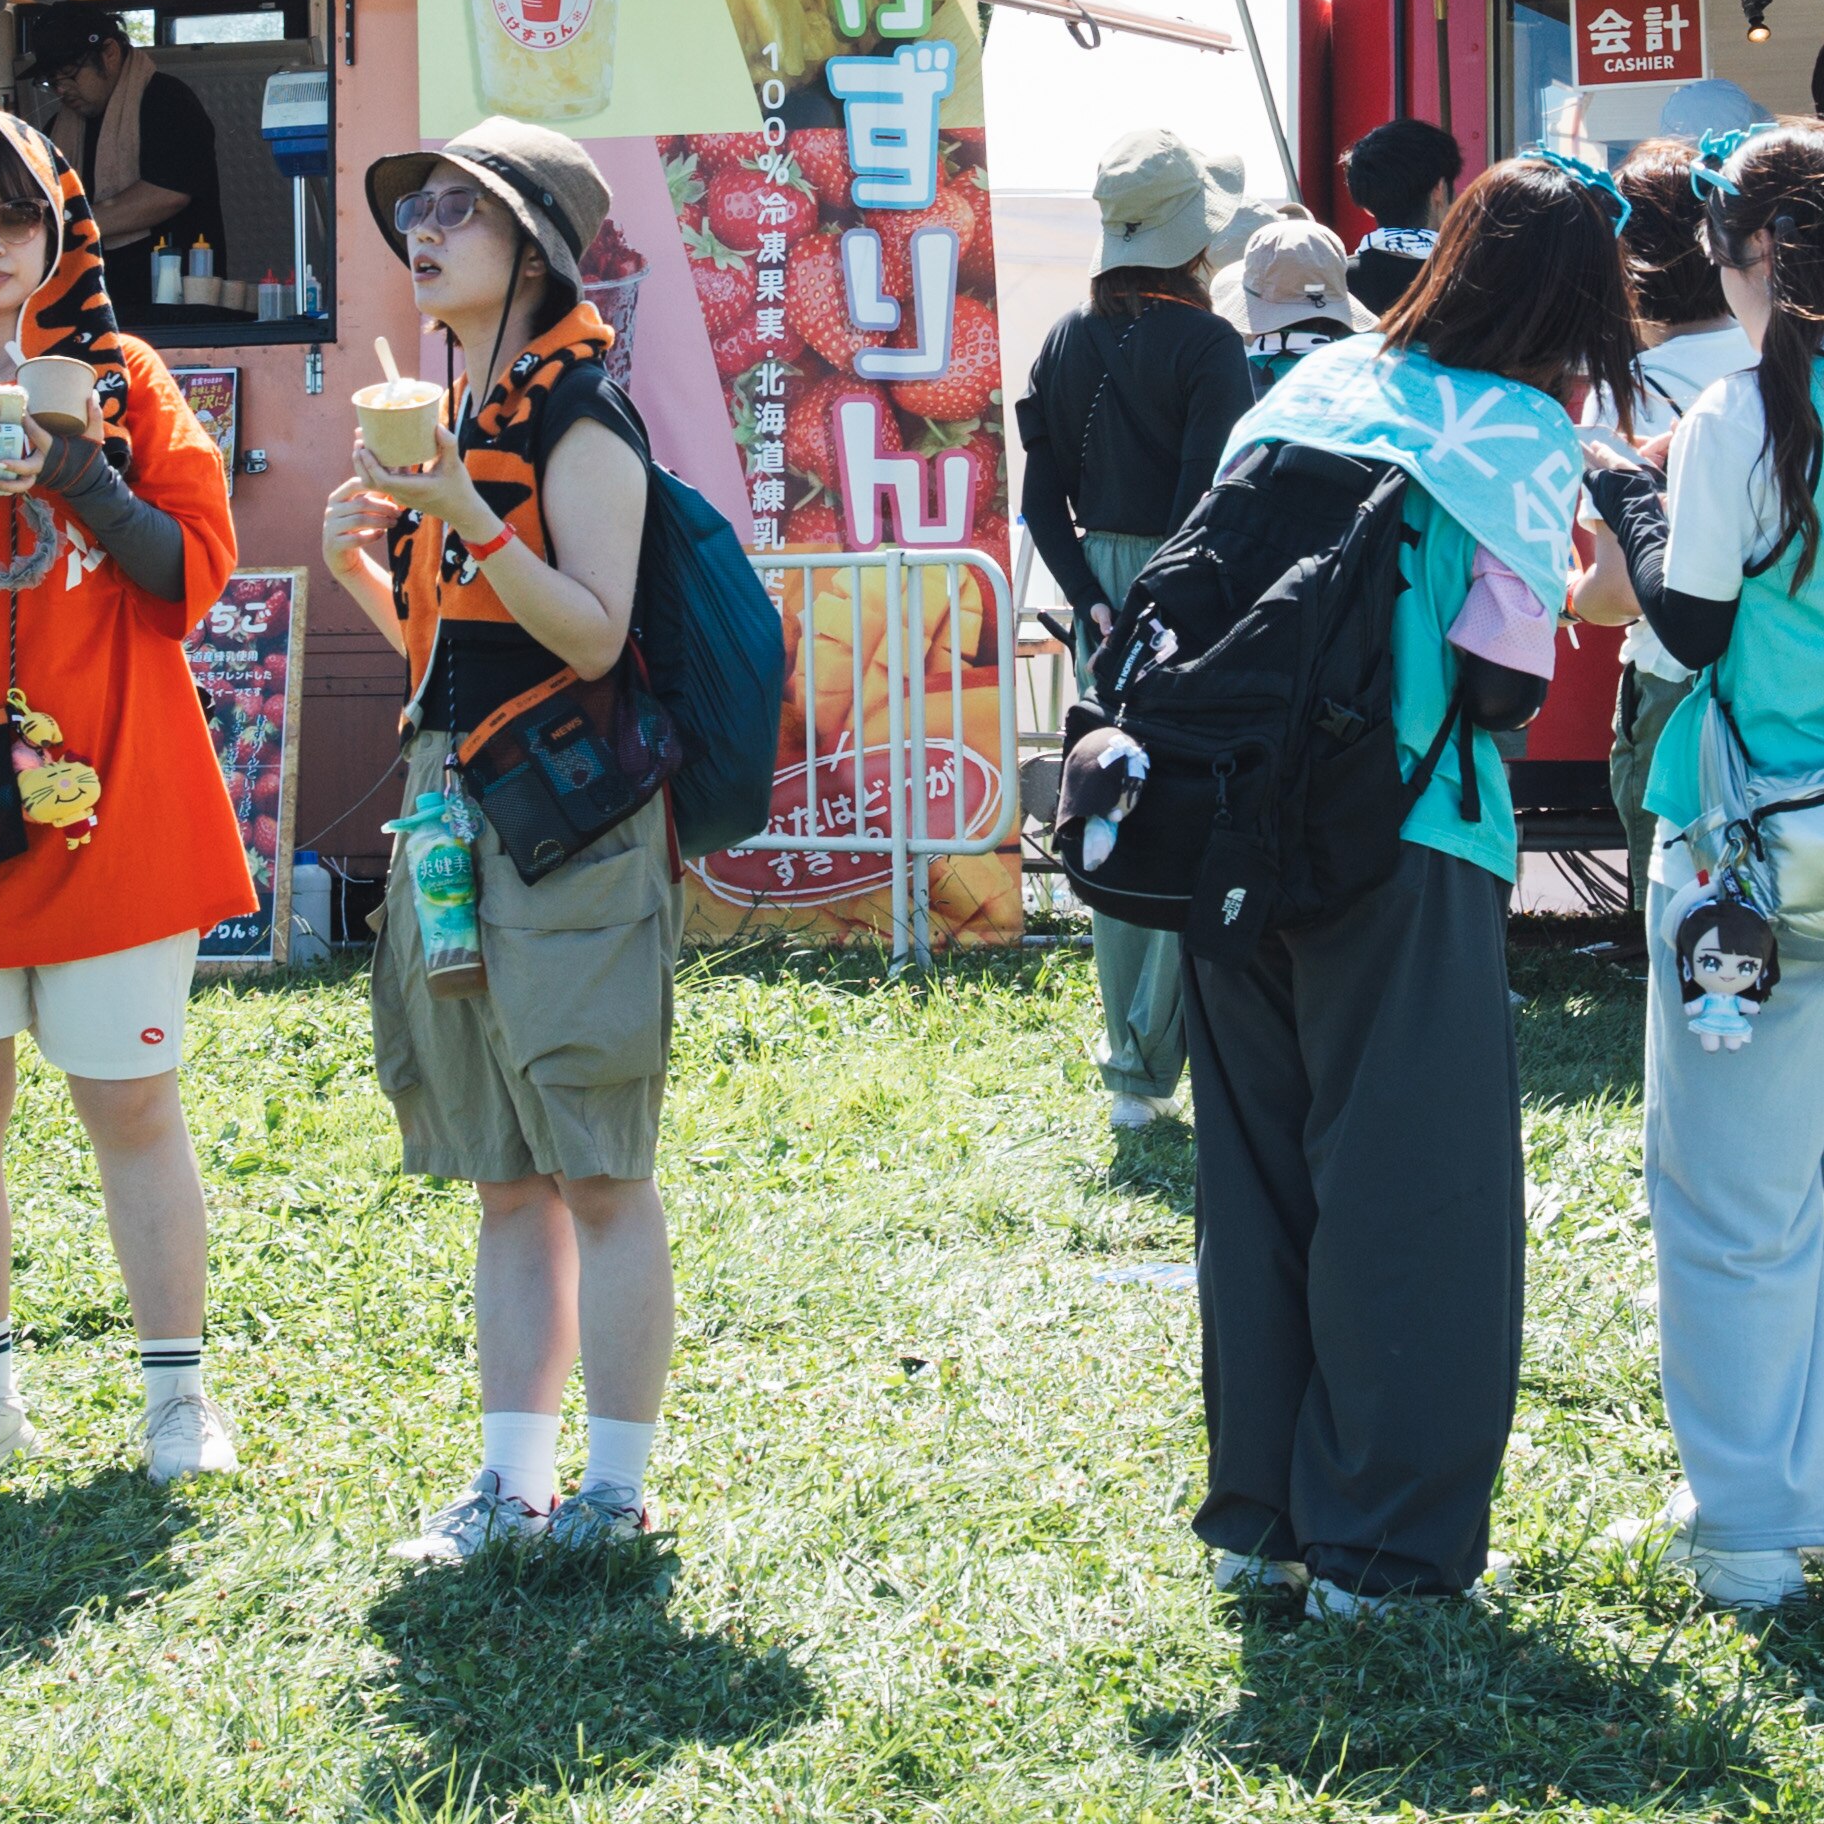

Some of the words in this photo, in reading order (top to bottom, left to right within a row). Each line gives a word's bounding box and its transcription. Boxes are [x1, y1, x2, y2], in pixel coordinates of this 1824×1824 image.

[506, 16, 573, 45] けずりん
[1587, 3, 1689, 56] 会計
[1603, 55, 1675, 73] CASHIER
[196, 601, 272, 633] ちご
[550, 716, 583, 740] NEWS
